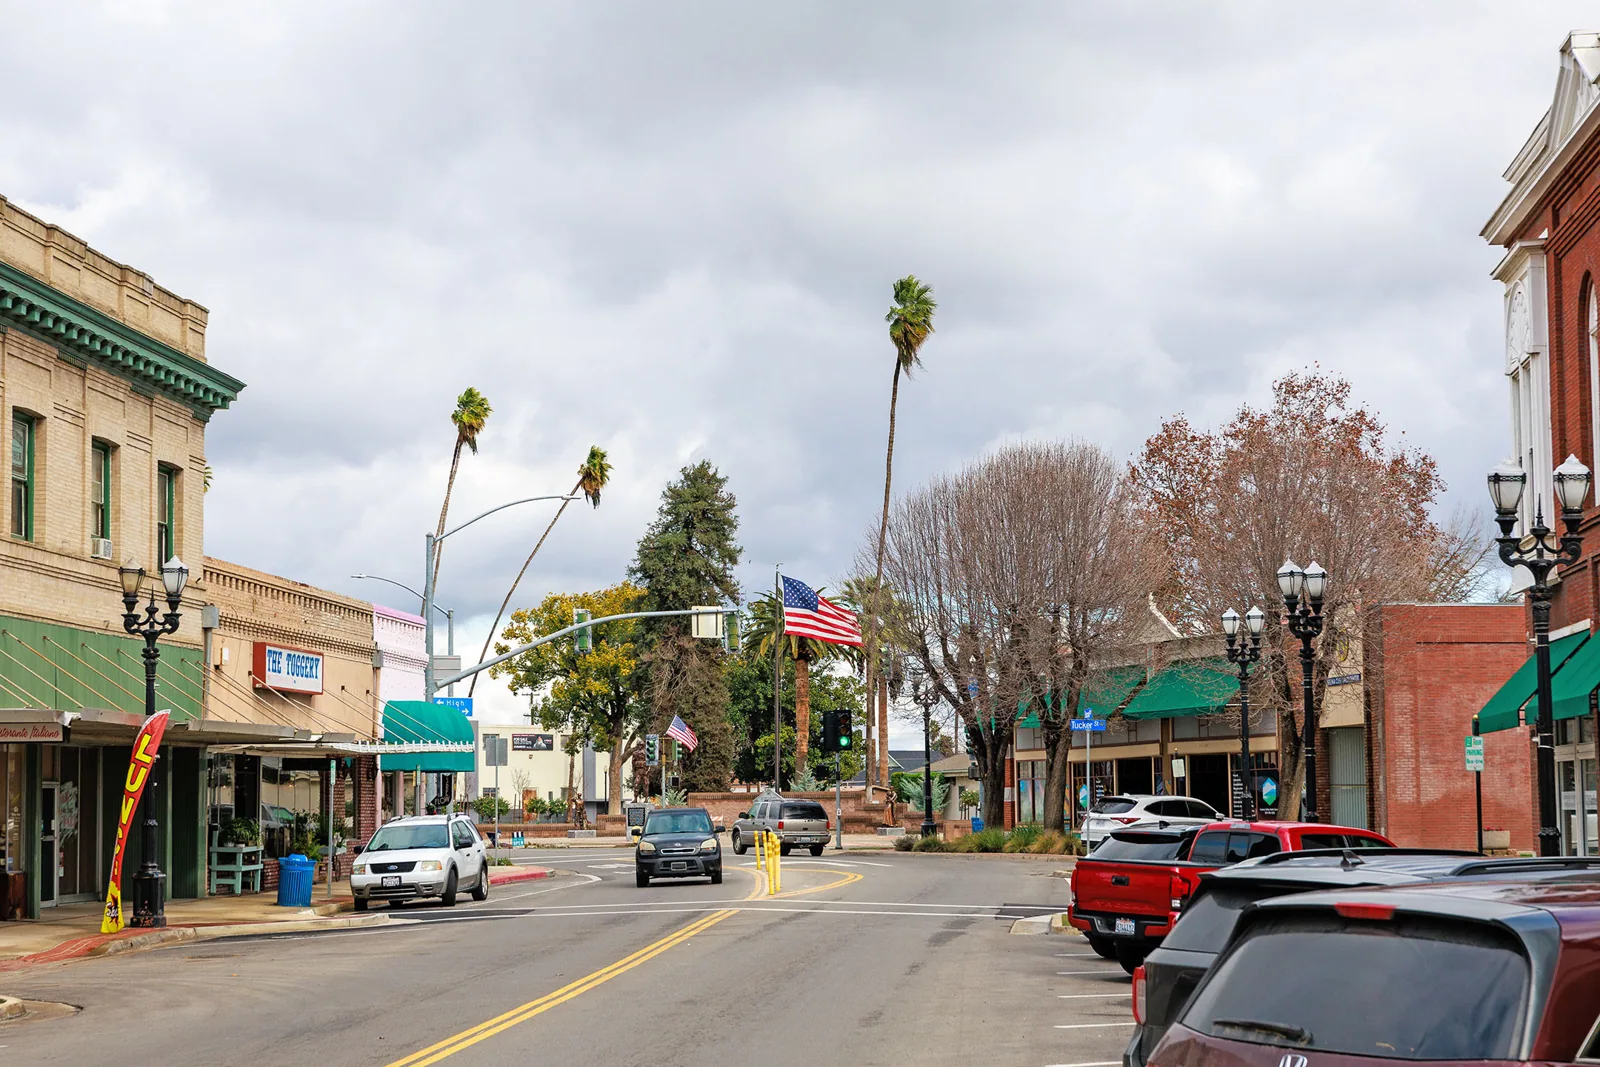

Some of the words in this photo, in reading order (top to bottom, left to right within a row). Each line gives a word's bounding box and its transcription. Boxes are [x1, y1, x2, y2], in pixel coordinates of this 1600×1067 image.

[267, 649, 282, 674] THE
[286, 653, 320, 679] TOGGERY
[446, 700, 465, 708] High
[1071, 721, 1093, 730] Tucker
[29, 725, 60, 740] Italiano
